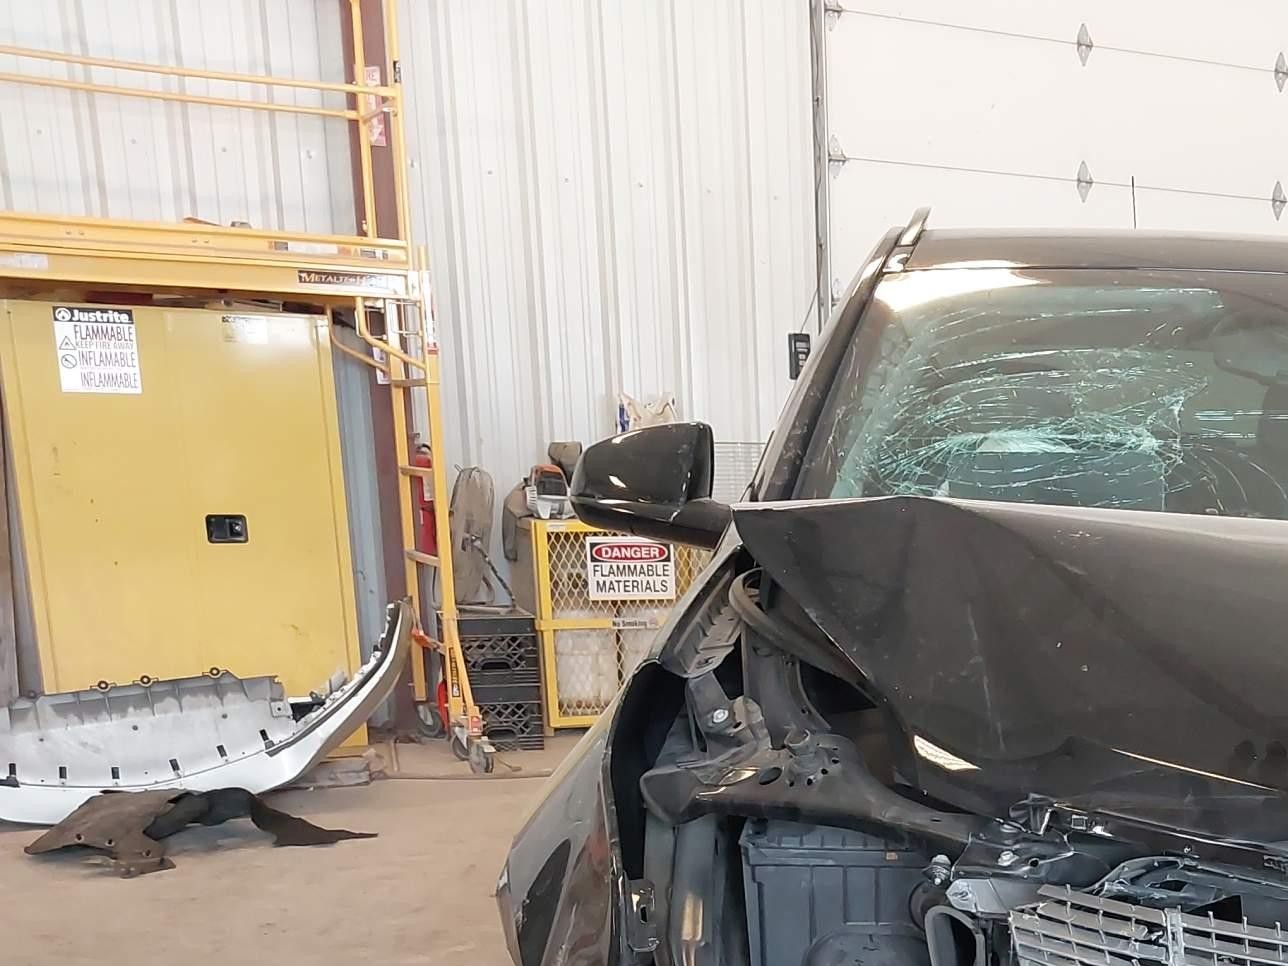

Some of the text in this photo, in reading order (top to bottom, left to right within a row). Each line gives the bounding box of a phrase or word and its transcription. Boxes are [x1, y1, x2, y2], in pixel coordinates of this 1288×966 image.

[72, 309, 131, 322] Justrite
[73, 324, 134, 342] FLAMMABLE
[76, 340, 94, 349] KEEP
[78, 350, 136, 368] INFLAMABLE
[80, 371, 139, 389] INFLAMMABLE
[601, 547, 660, 558] DANGER
[592, 564, 670, 577] FLAMMABLE
[596, 580, 669, 593] MATERIALS
[622, 620, 648, 629] Smoking
